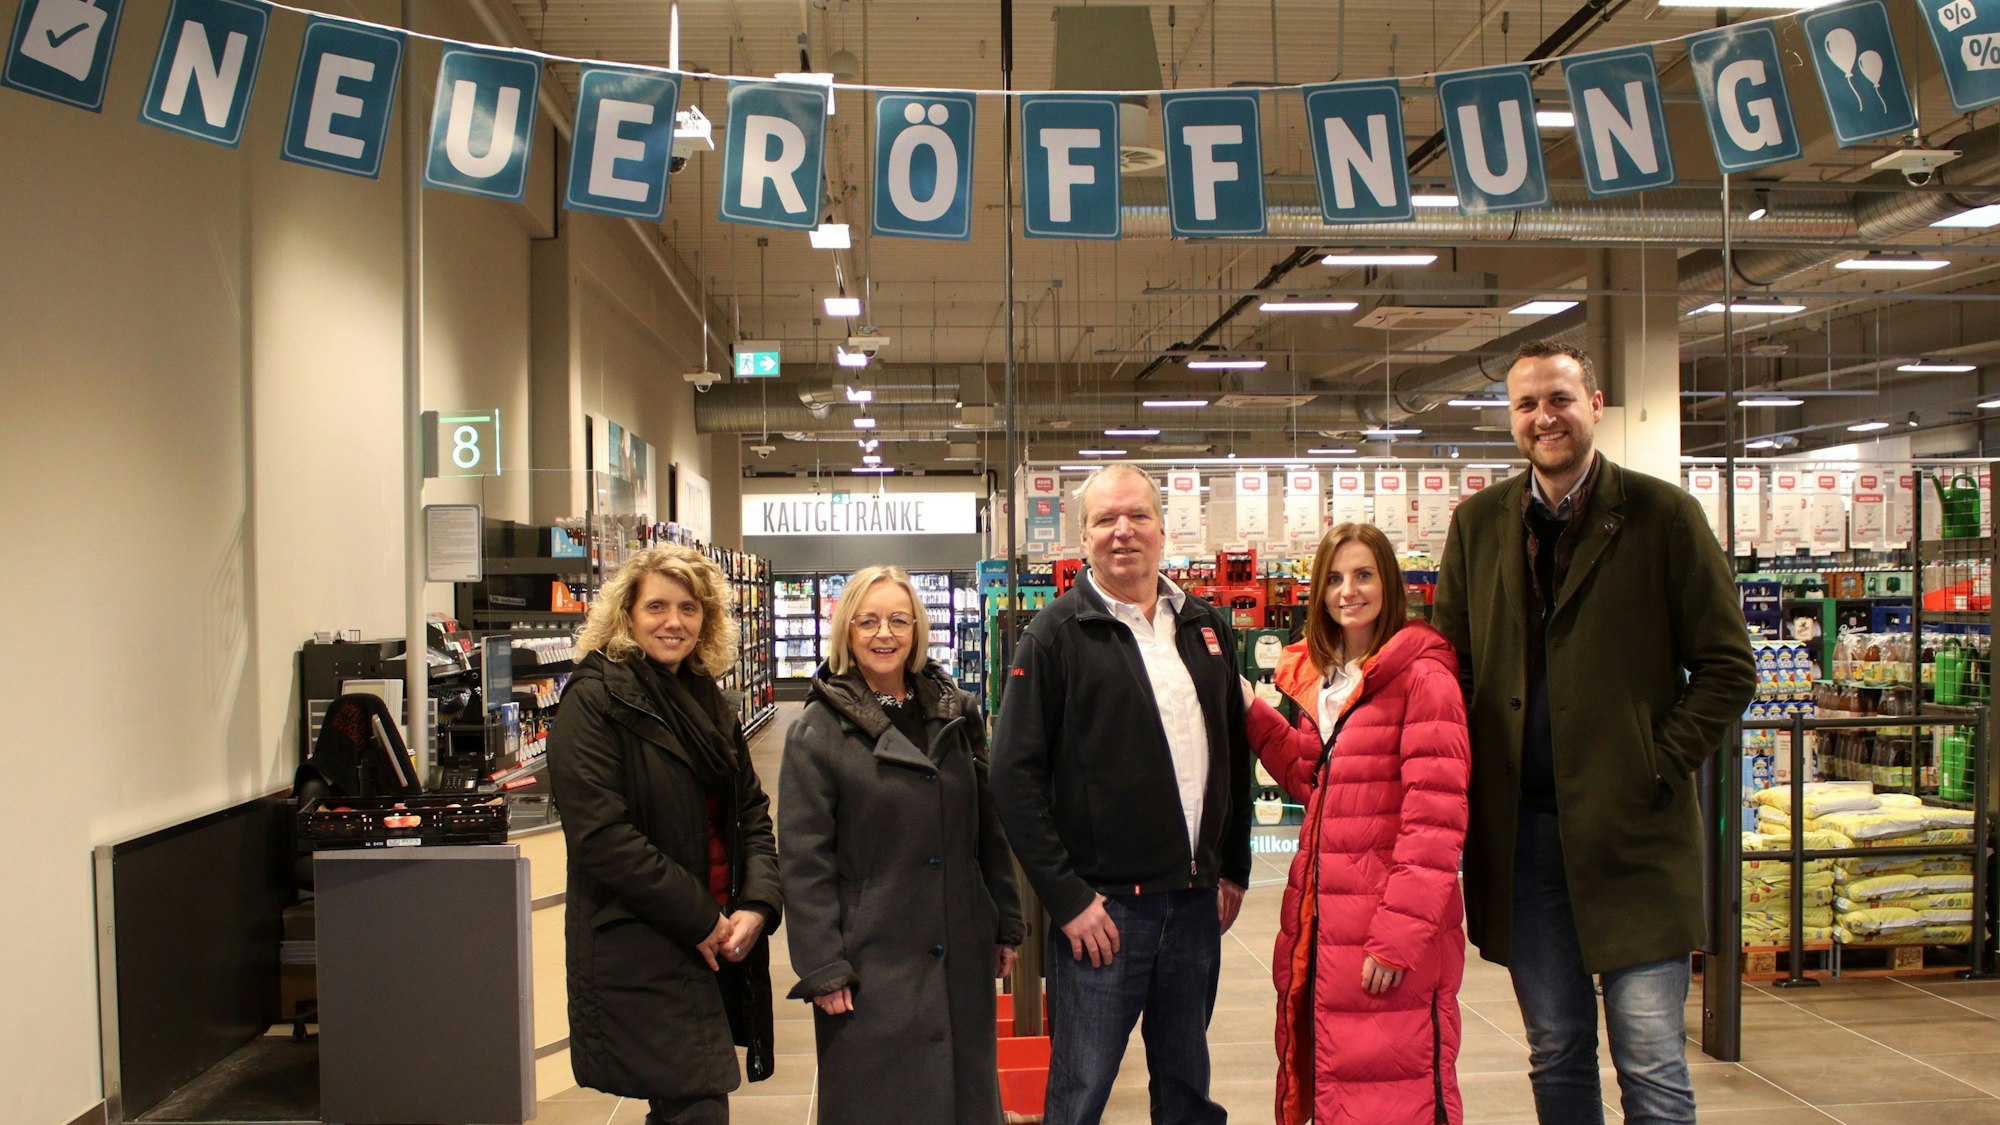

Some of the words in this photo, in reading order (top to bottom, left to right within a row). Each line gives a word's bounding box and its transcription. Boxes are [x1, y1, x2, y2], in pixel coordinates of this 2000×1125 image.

[161, 20, 1783, 222] NEUERÖFFNUNG
[452, 425, 481, 469] 8
[763, 495, 926, 532] KALTGETRÄNKE
